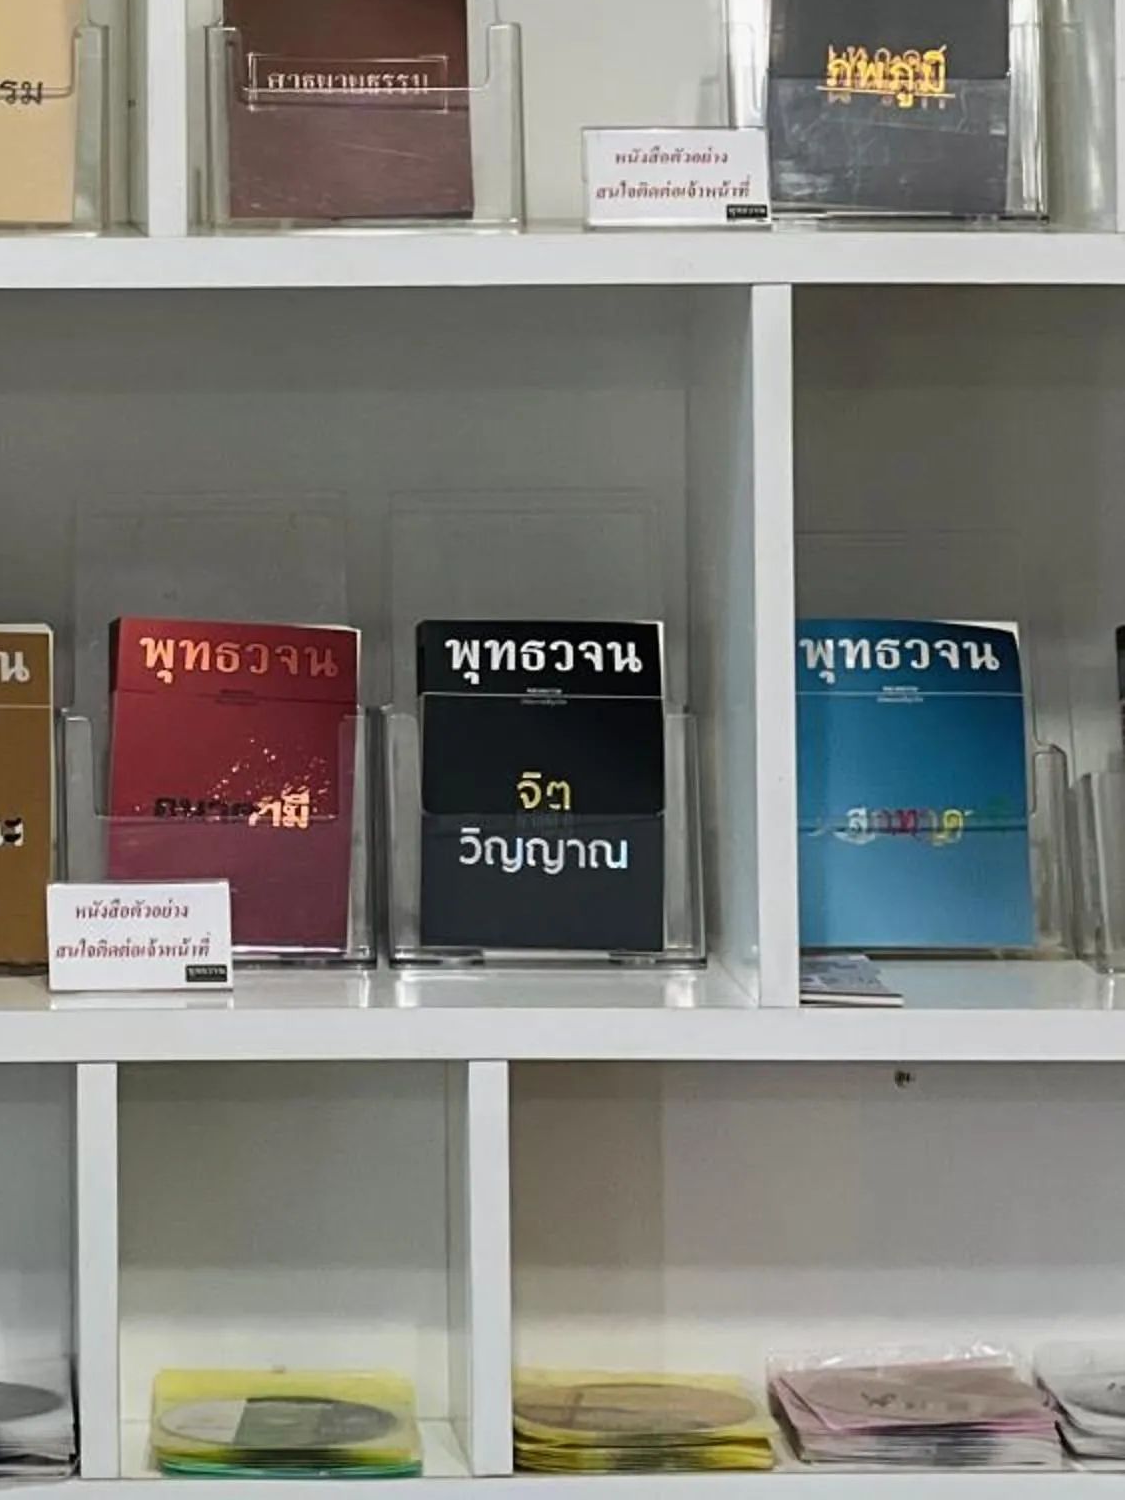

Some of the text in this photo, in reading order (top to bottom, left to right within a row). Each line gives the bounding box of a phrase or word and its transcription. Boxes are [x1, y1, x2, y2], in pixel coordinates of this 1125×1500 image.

[139, 637, 339, 684] พุทธวจน
[444, 639, 643, 684] พุทธวจน
[799, 638, 1001, 684] พุทธวจน
[459, 827, 628, 874] วิญญาณ
